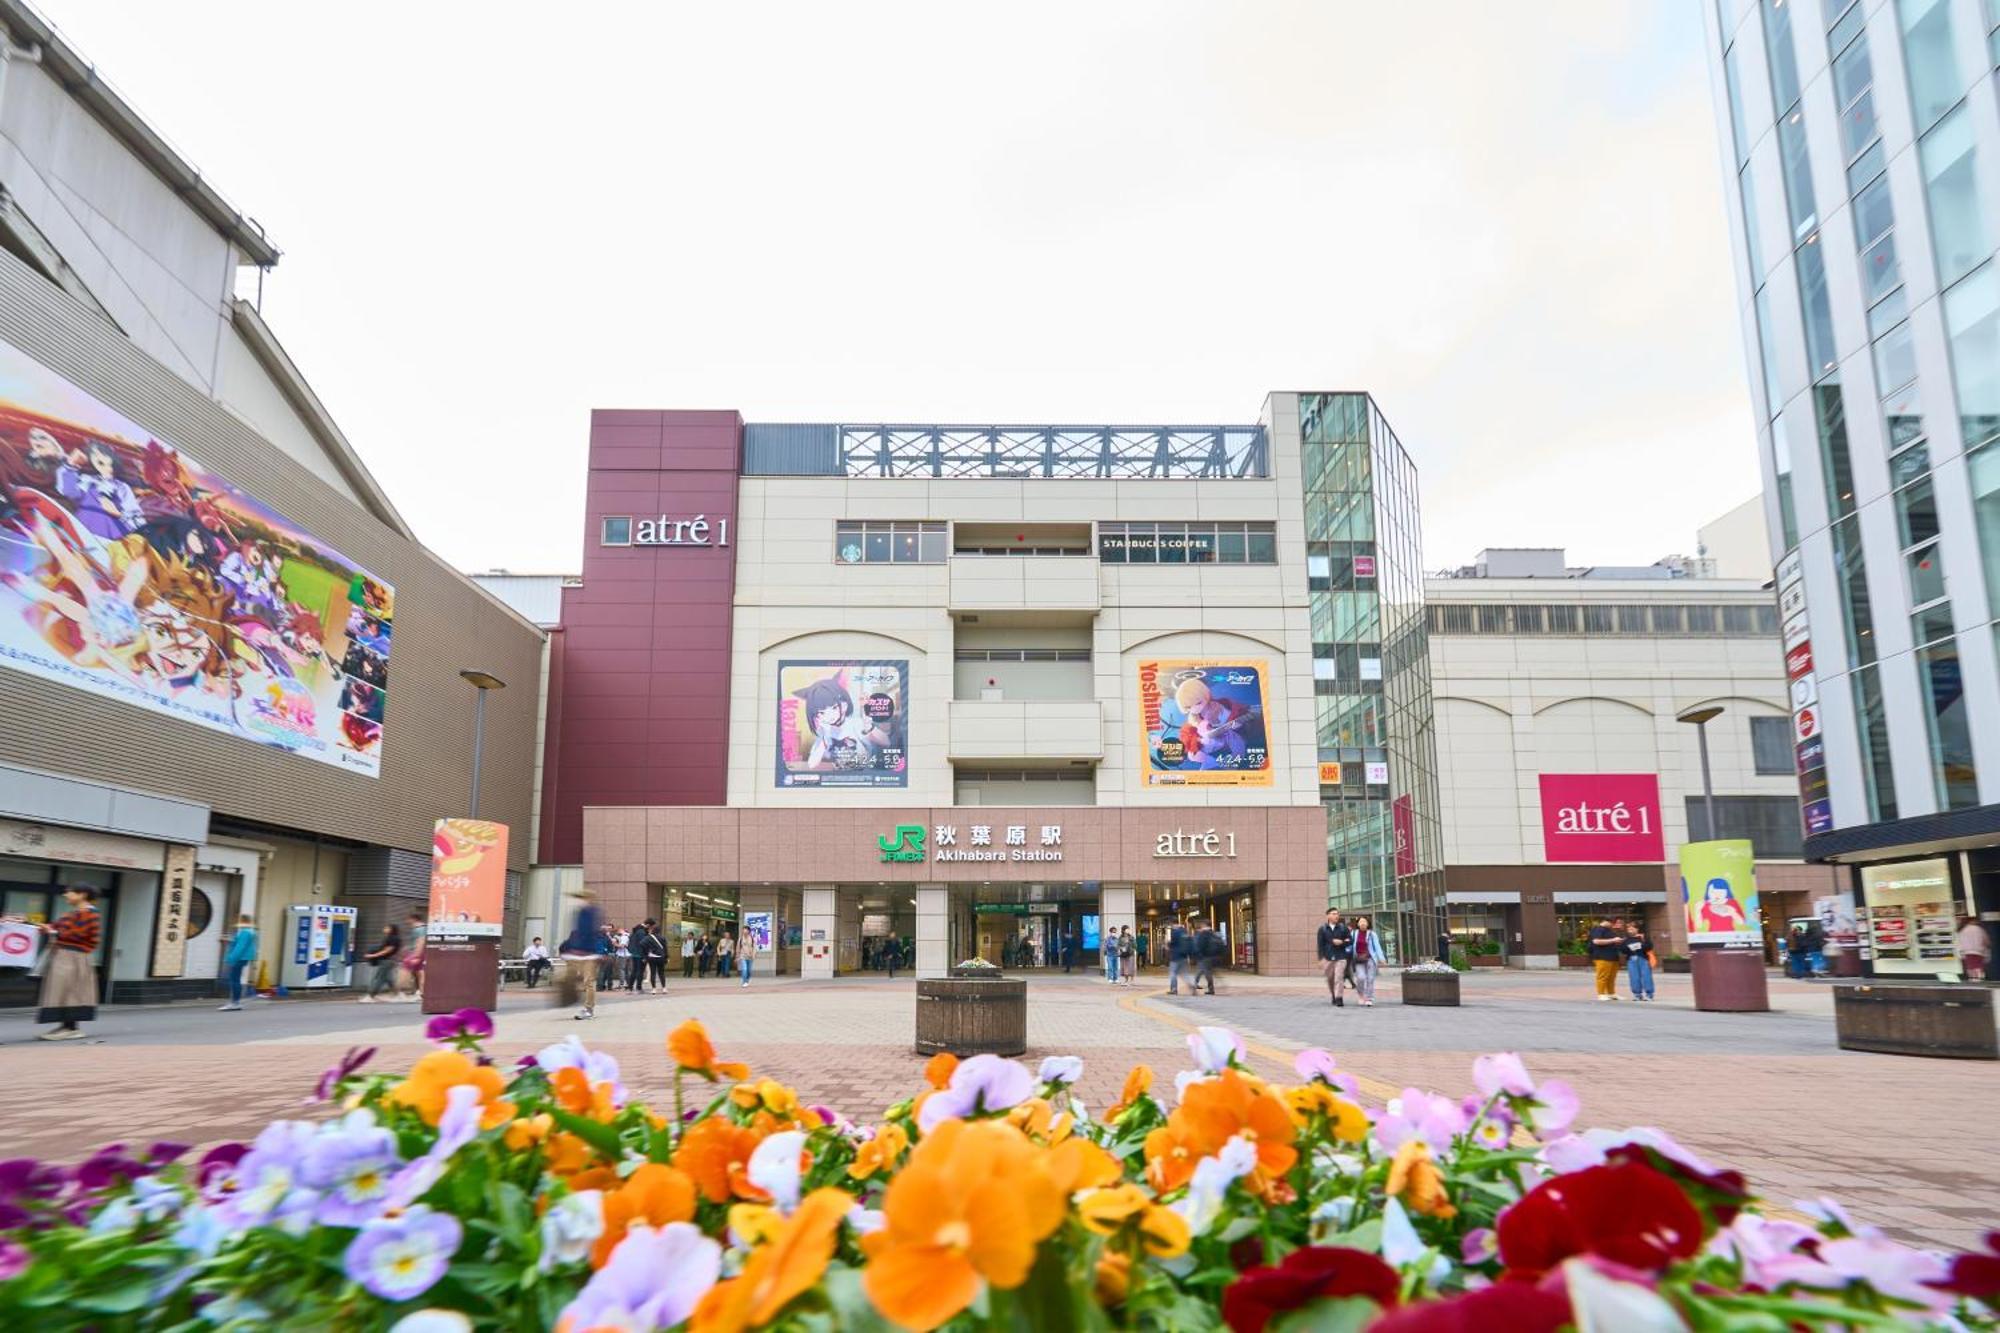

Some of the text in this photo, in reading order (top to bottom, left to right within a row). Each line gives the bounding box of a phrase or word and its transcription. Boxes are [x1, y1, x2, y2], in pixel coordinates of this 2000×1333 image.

[636, 514, 729, 546] atré 1
[1557, 801, 1652, 834] atré 1
[878, 824, 927, 852] JR
[936, 825, 1062, 847] 秋葉原駅
[1156, 827, 1237, 857] atré 1
[936, 849, 1062, 862] Akihabara Station
